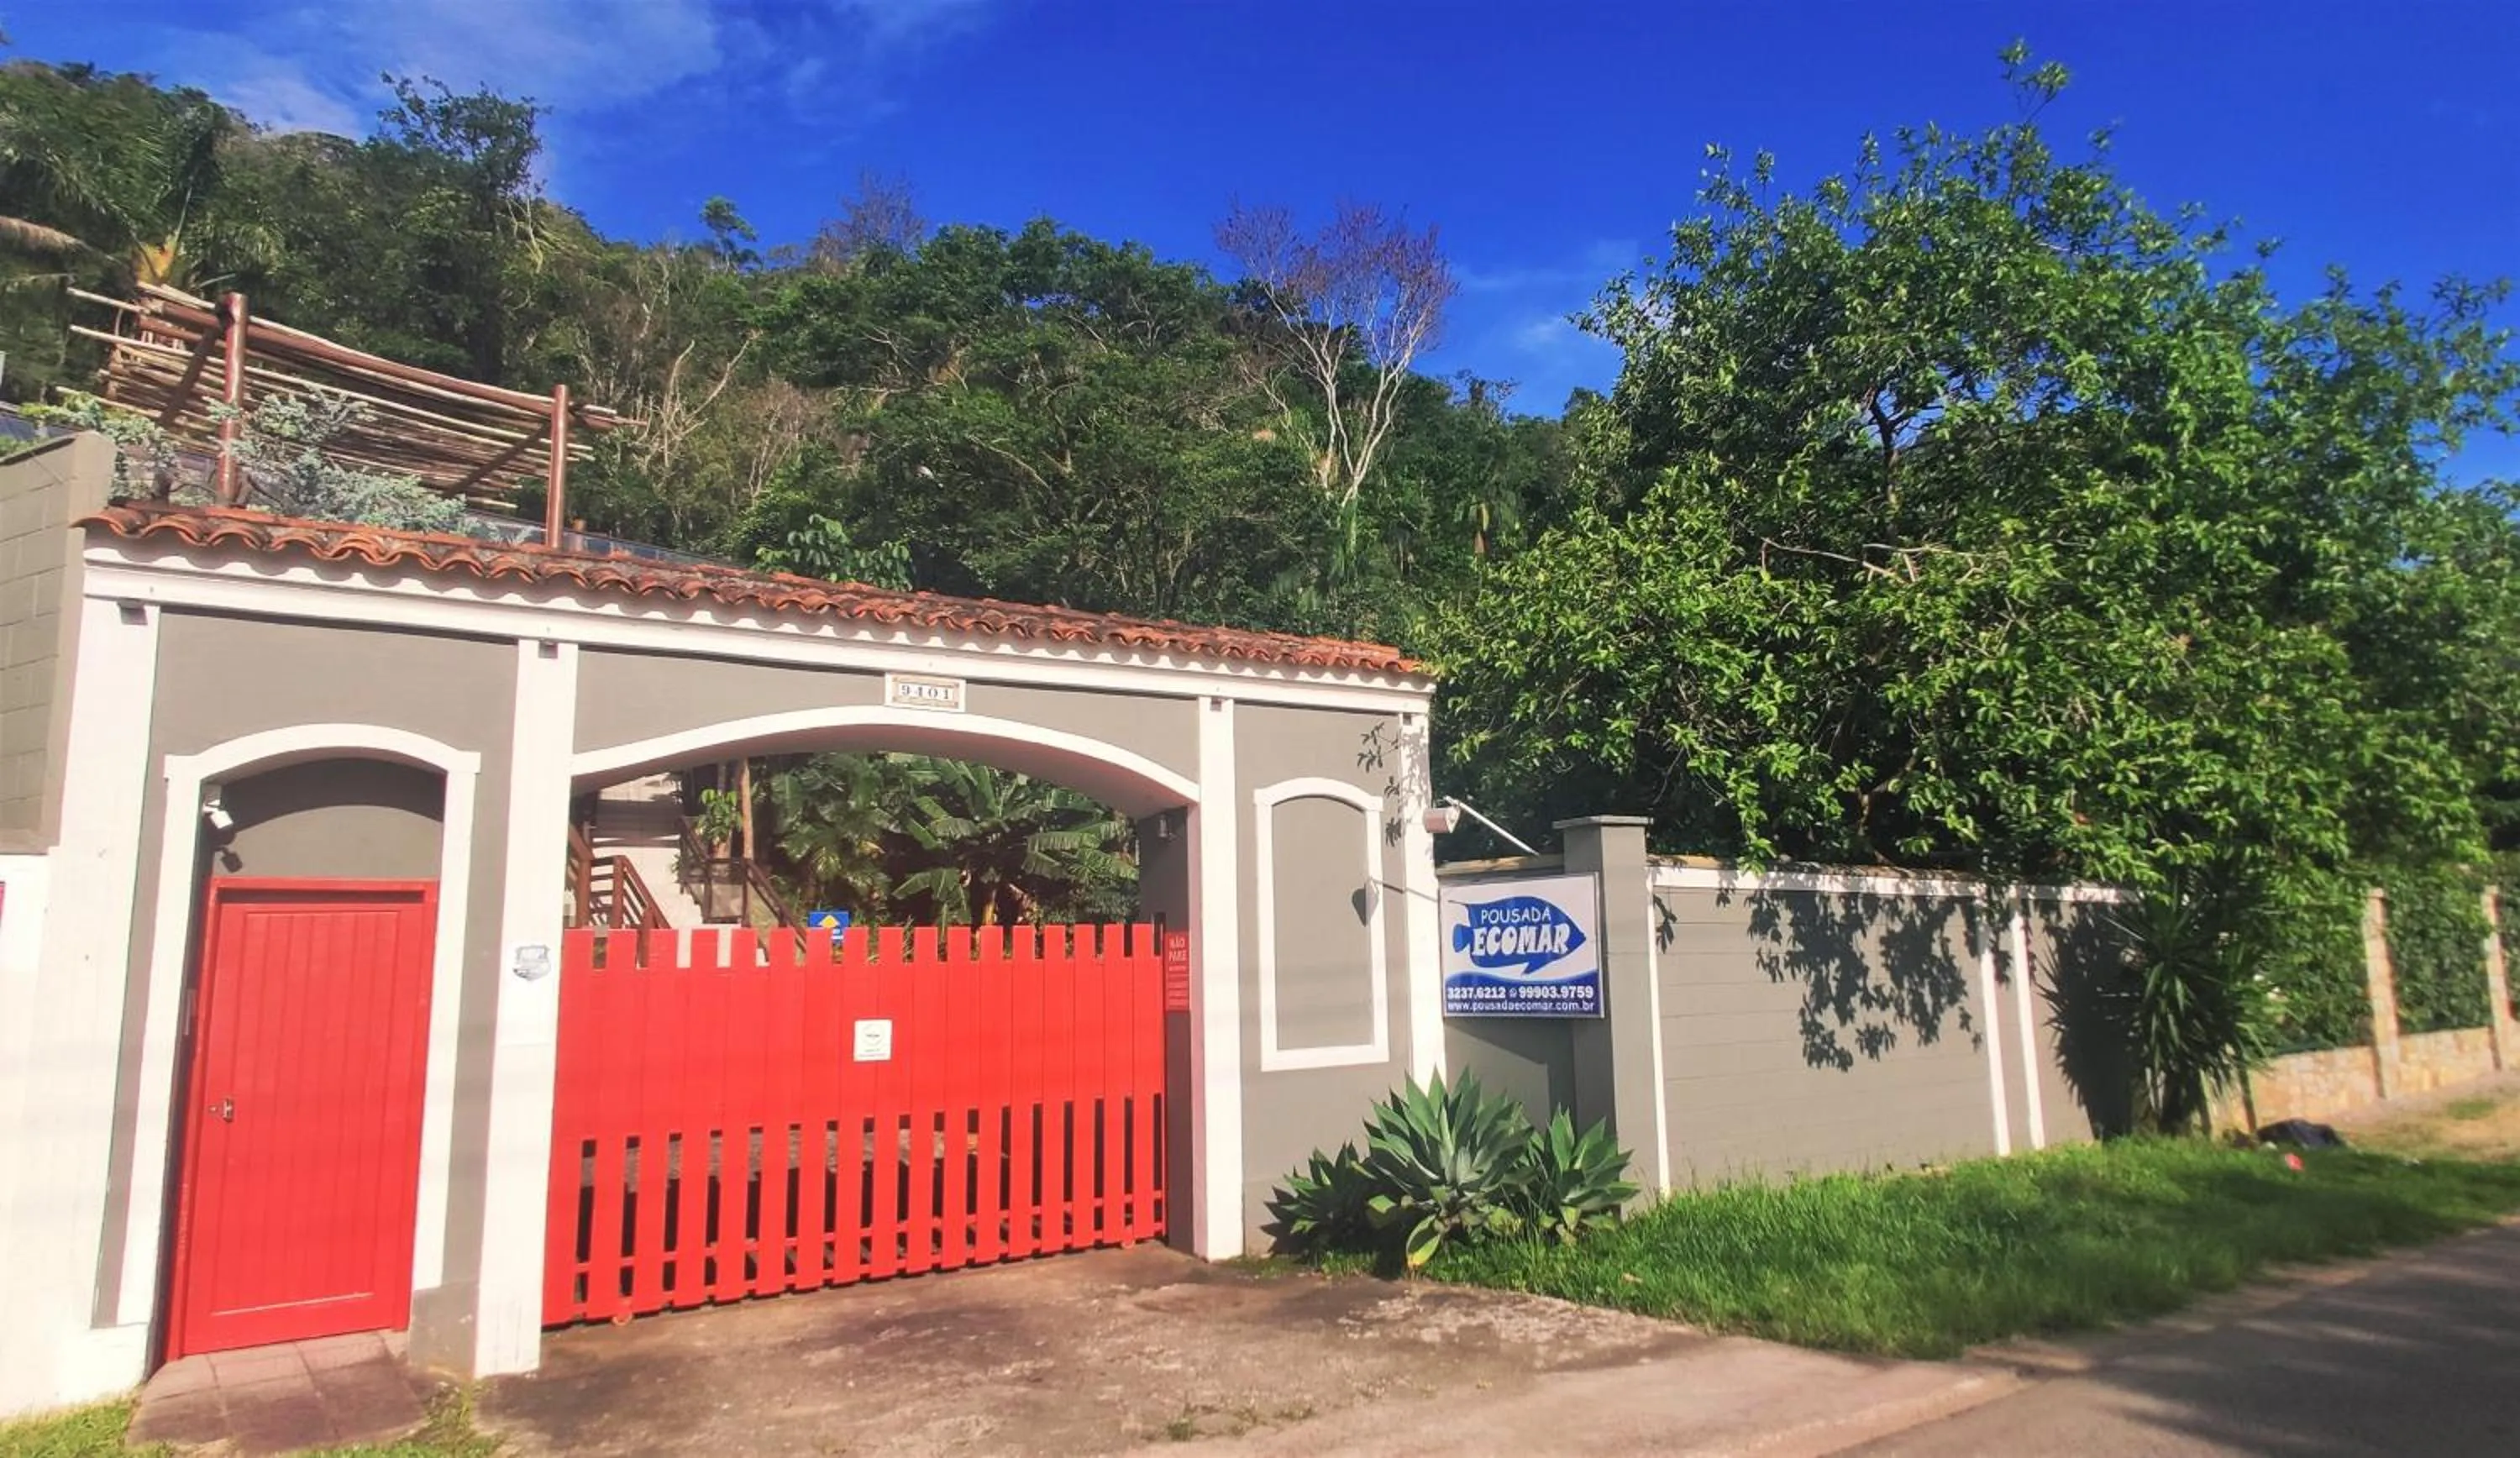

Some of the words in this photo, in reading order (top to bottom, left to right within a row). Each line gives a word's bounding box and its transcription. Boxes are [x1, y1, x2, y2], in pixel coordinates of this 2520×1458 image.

[1481, 907, 1551, 924] POUSADA
[1472, 923, 1570, 957] ECOMAR
[1447, 987, 1506, 999] 3237.6212
[1518, 985, 1593, 999] 99903.9759
[1447, 999, 1594, 1012] www.pousadaecomar.com.br
